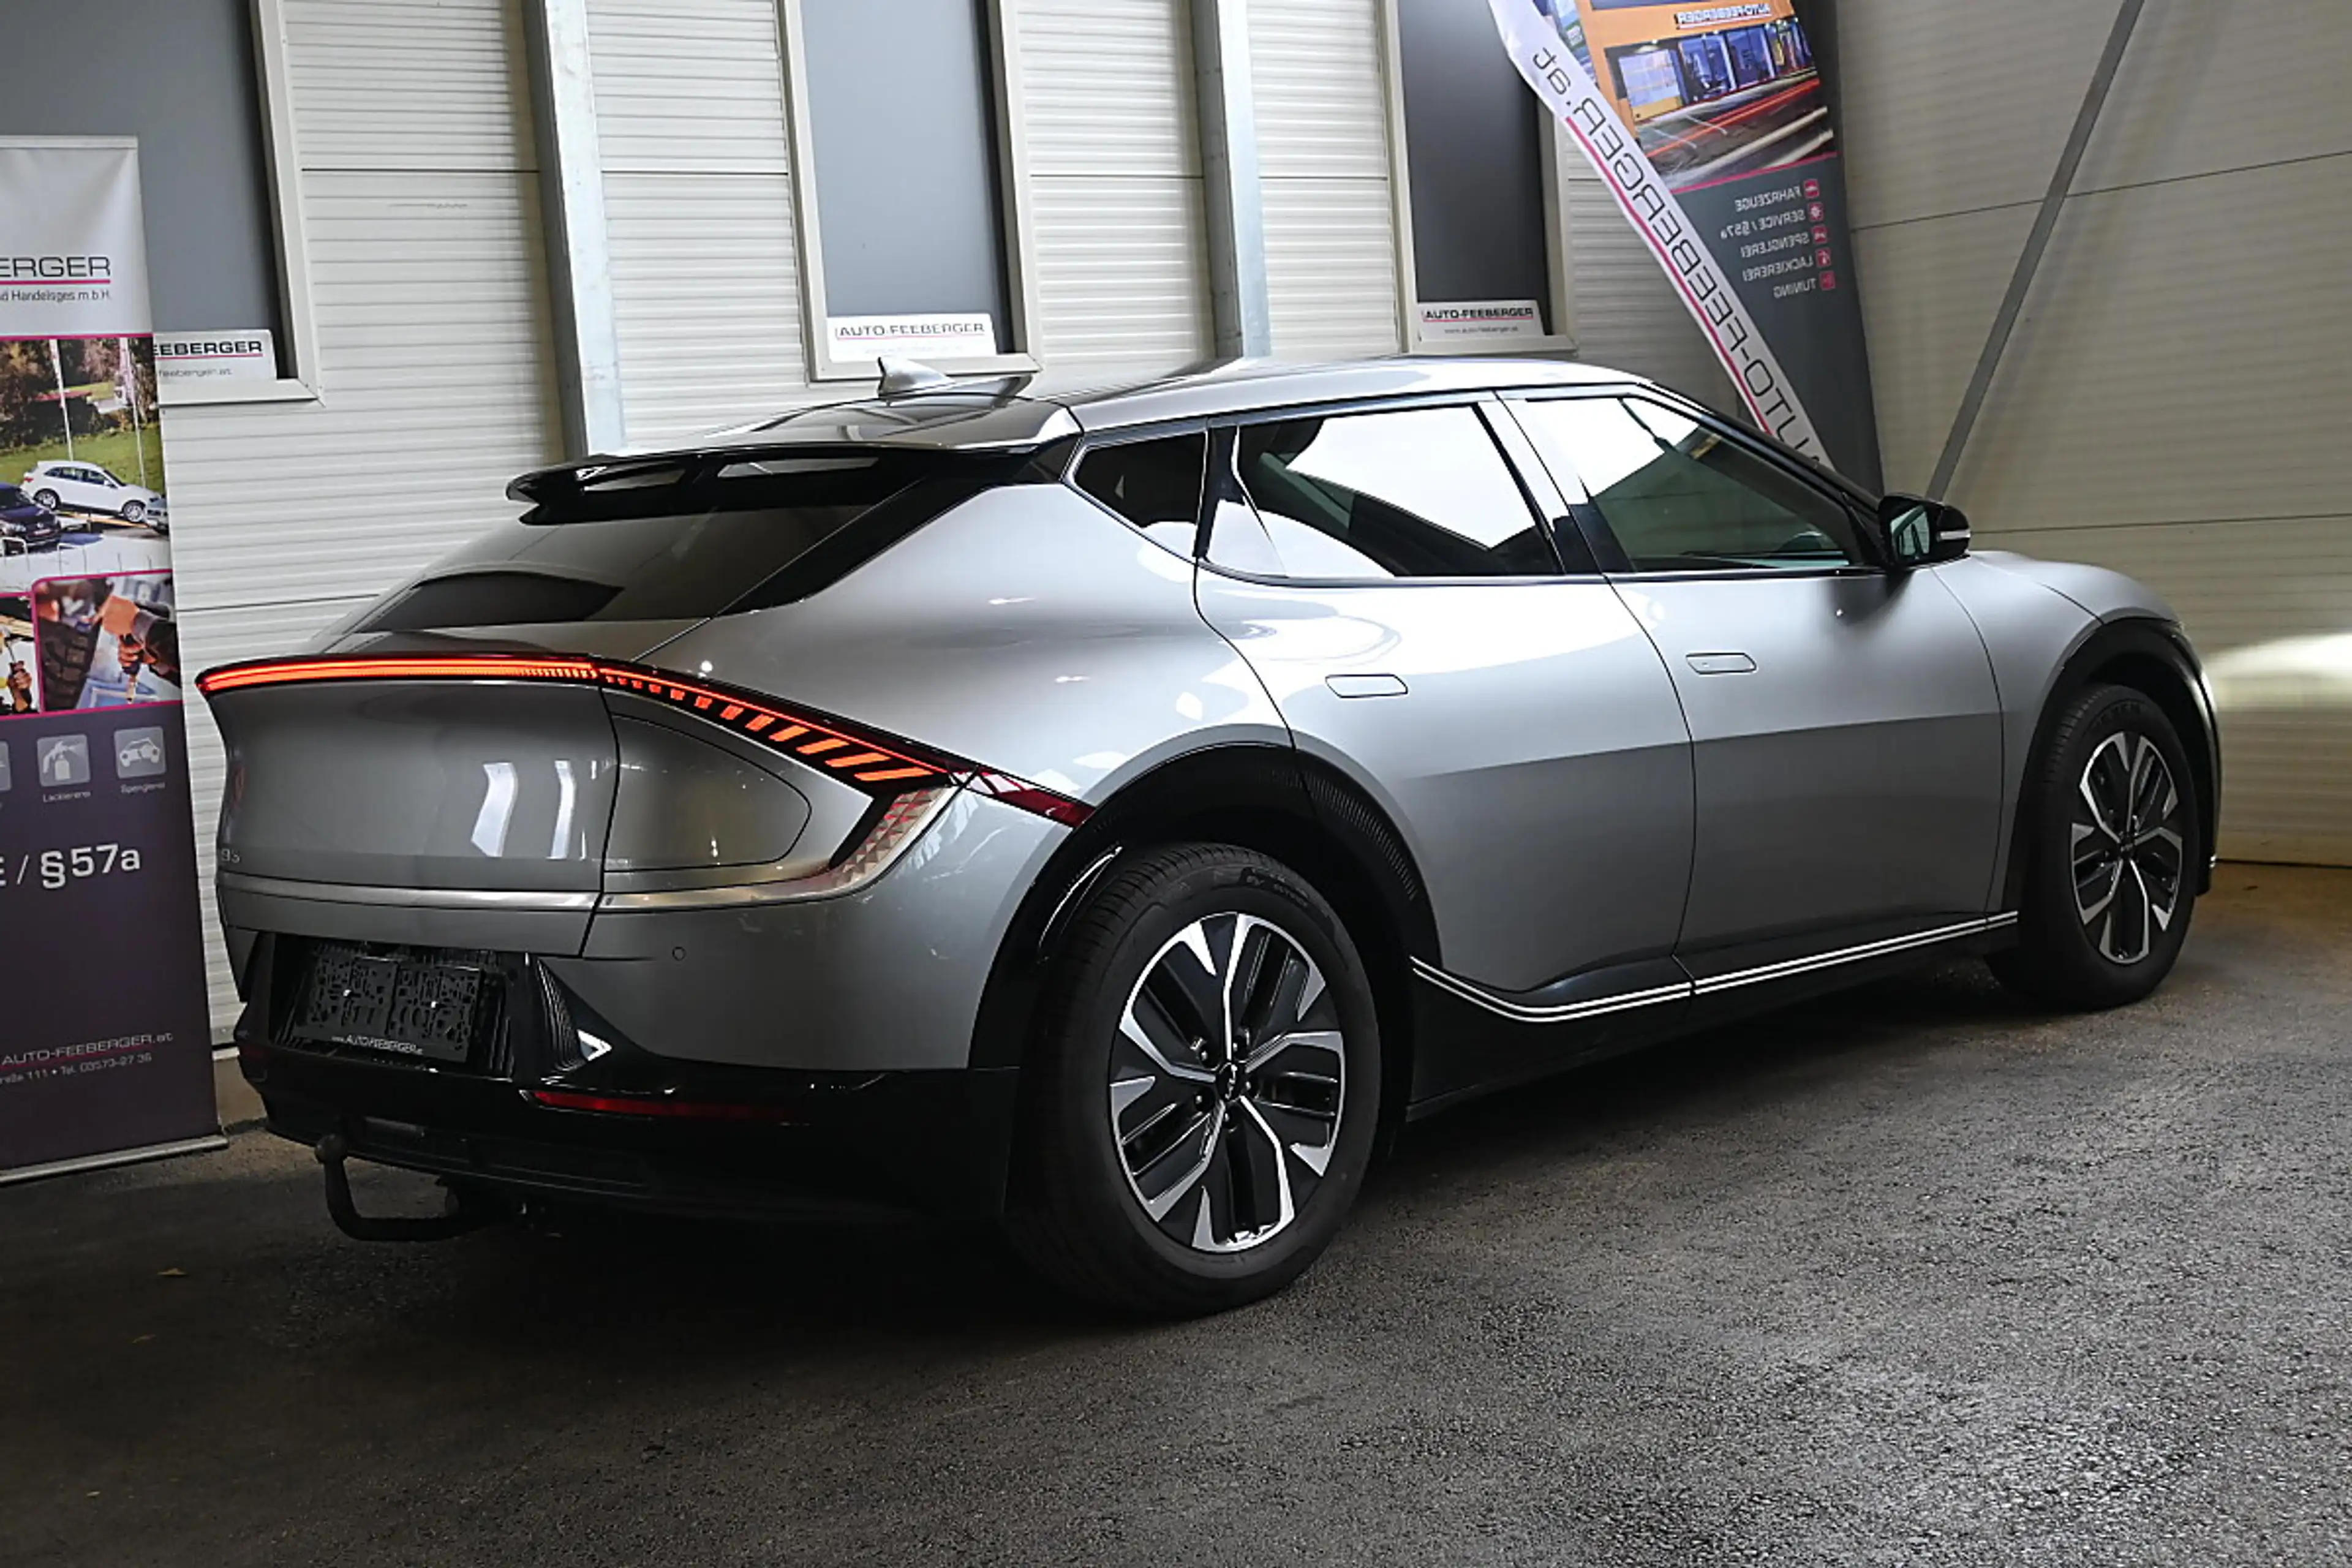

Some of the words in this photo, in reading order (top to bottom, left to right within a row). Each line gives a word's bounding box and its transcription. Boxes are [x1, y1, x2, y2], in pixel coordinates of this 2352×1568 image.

[0, 256, 111, 277] ERGER
[40, 843, 141, 889] §57a
[1, 1032, 173, 1066] AUTO-FEEBERGER.at
